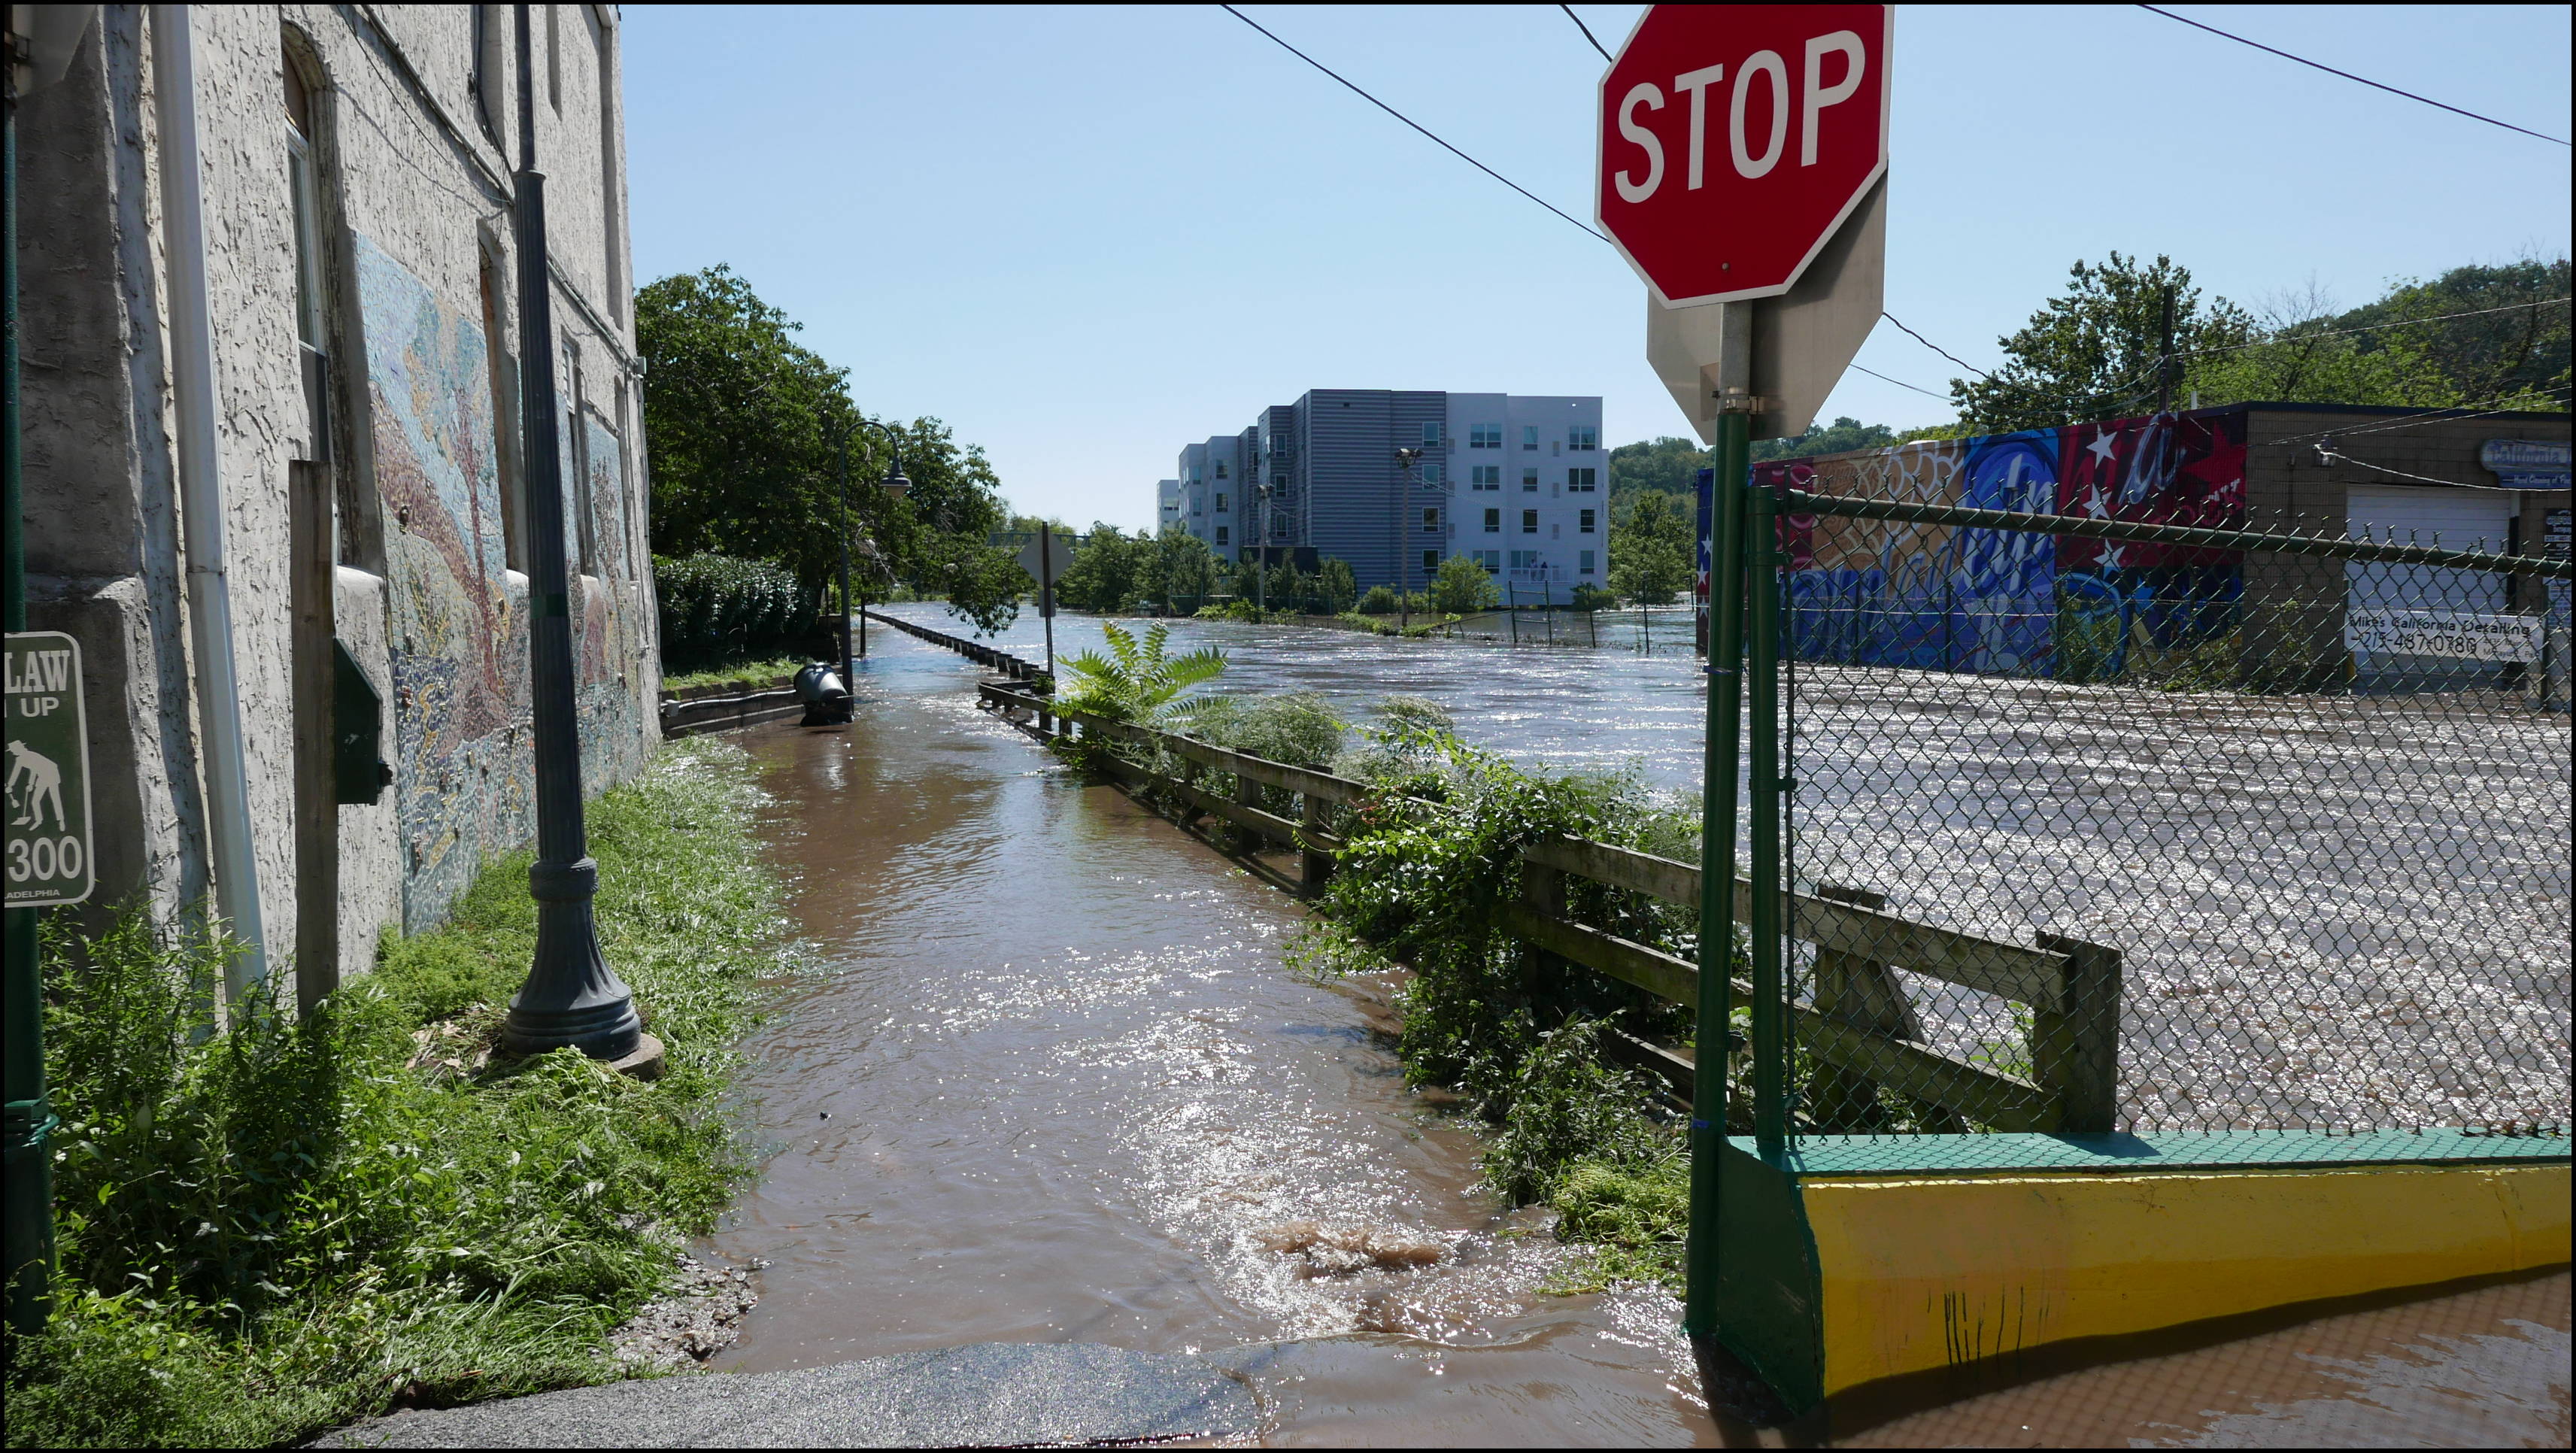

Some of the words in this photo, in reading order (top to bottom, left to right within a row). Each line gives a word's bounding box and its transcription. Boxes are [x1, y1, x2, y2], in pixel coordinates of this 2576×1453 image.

[1615, 29, 1866, 203] STOP
[2350, 616, 2386, 627] Mike's
[2392, 617, 2456, 631] California
[2462, 620, 2530, 638] Detailing
[5, 650, 71, 693] LAW
[21, 696, 59, 717] UP
[8, 836, 83, 882] 300
